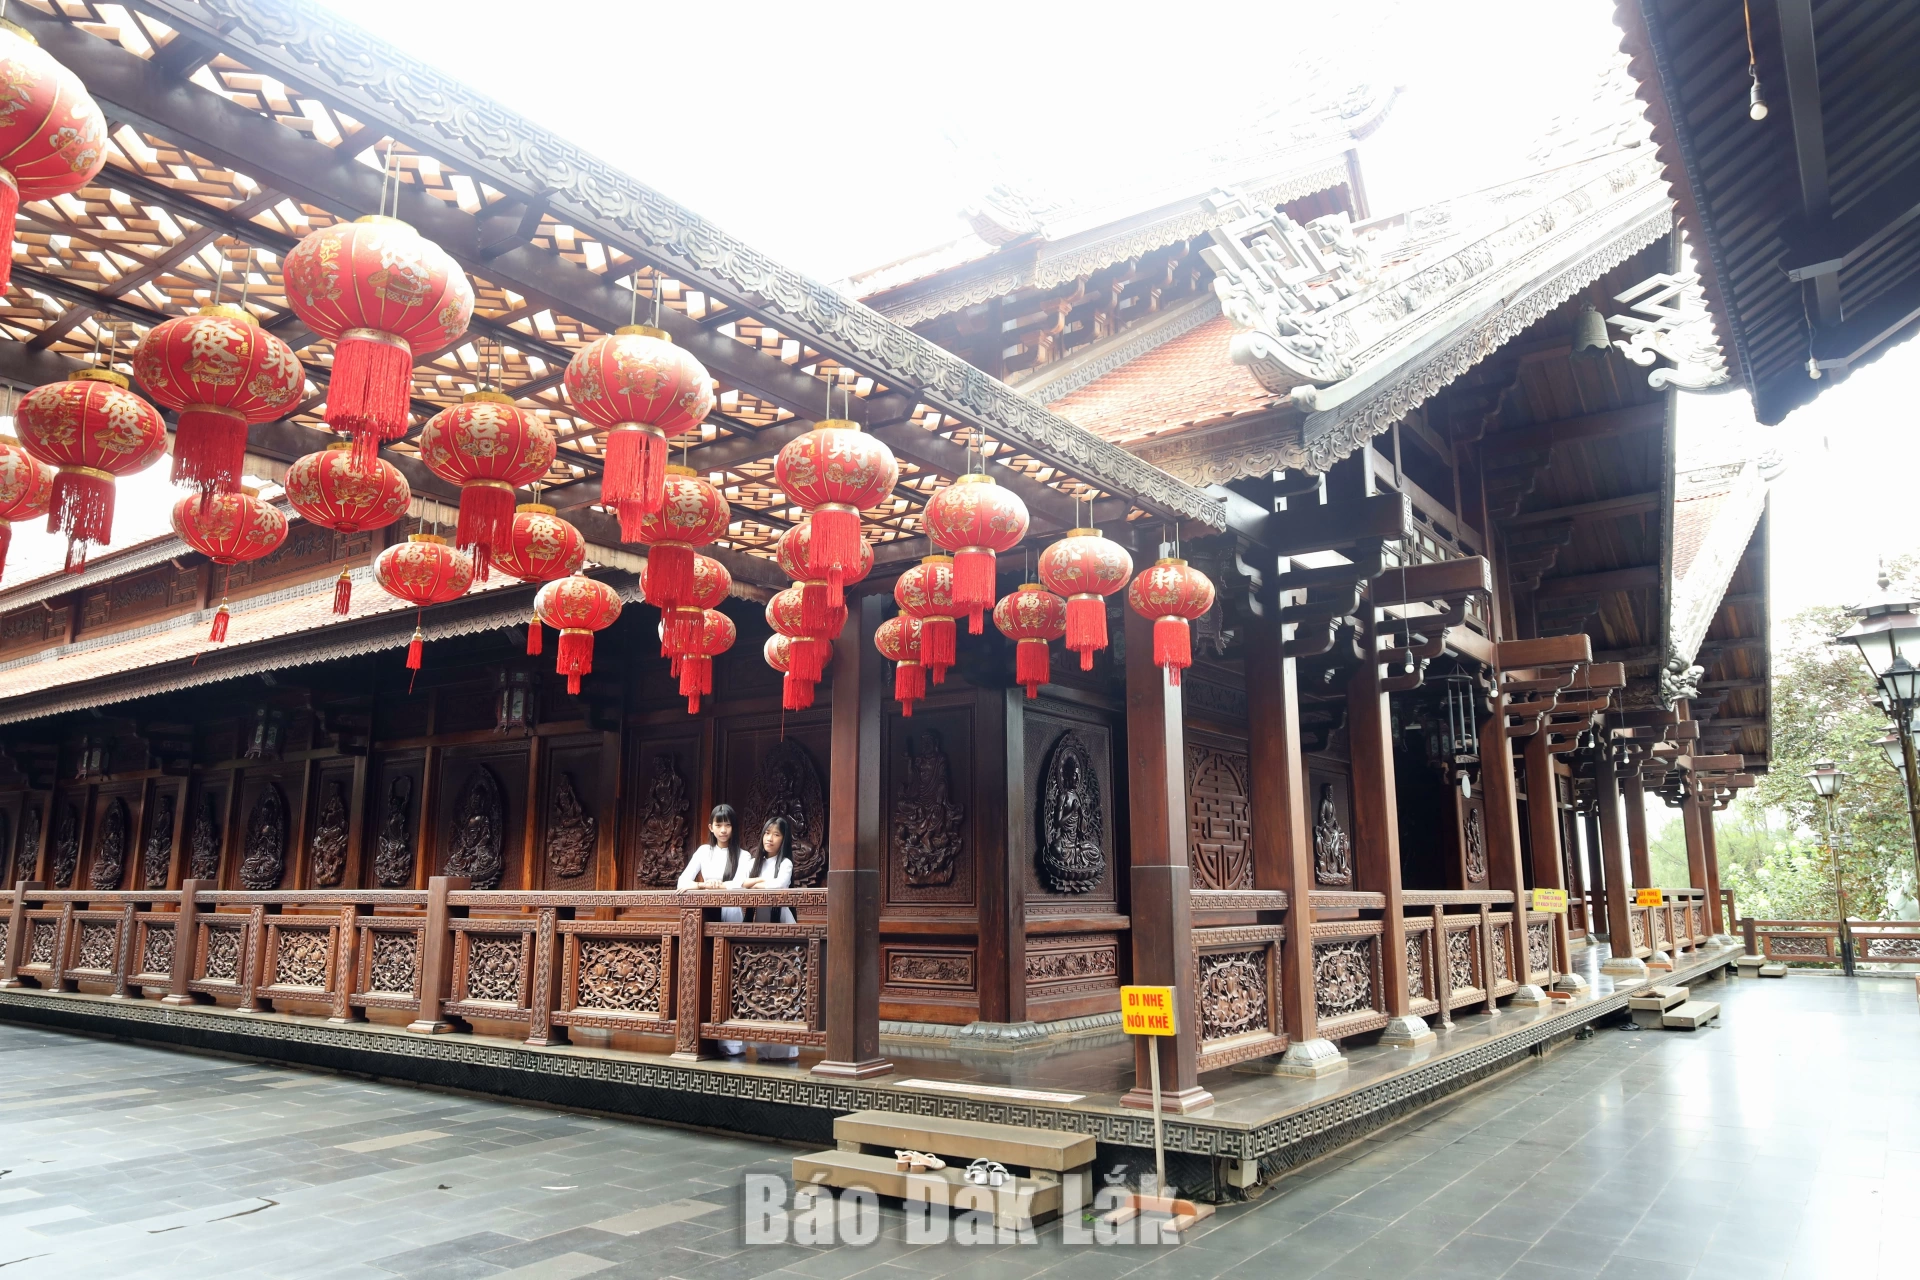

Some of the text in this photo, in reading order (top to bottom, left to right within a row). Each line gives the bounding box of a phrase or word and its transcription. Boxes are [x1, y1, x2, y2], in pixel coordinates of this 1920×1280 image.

[181, 319, 245, 363] 發
[98, 390, 148, 436] 發
[458, 404, 508, 440] 喜
[671, 480, 708, 514] 喜
[525, 516, 562, 545] 發
[398, 544, 425, 564] 福
[1149, 567, 1184, 590] 財
[1128, 993, 1164, 1010] ĐI NHẸ
[1127, 1012, 1169, 1029] NÓI KHẼ
